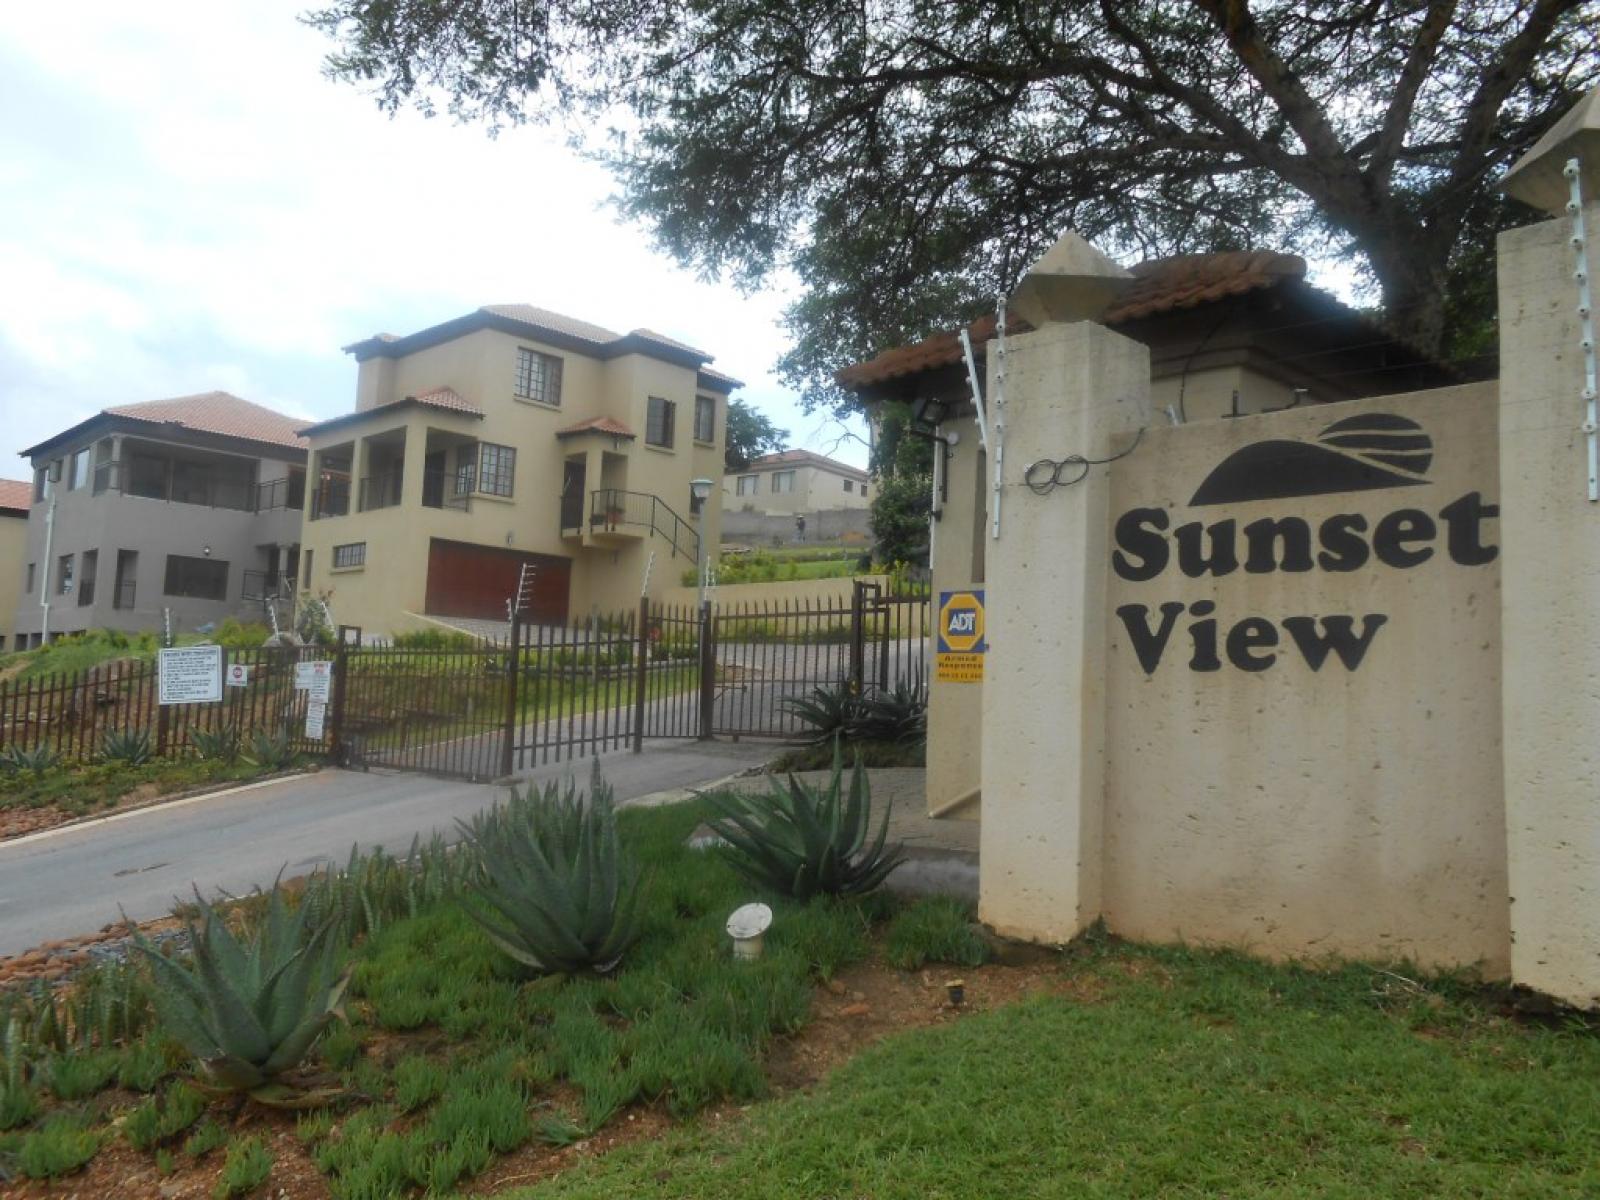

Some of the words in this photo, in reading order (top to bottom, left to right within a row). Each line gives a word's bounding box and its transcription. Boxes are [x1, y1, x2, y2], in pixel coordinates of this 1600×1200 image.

[1112, 491, 1500, 582] Sunset
[948, 613, 976, 631] ADT
[1116, 600, 1389, 675] View
